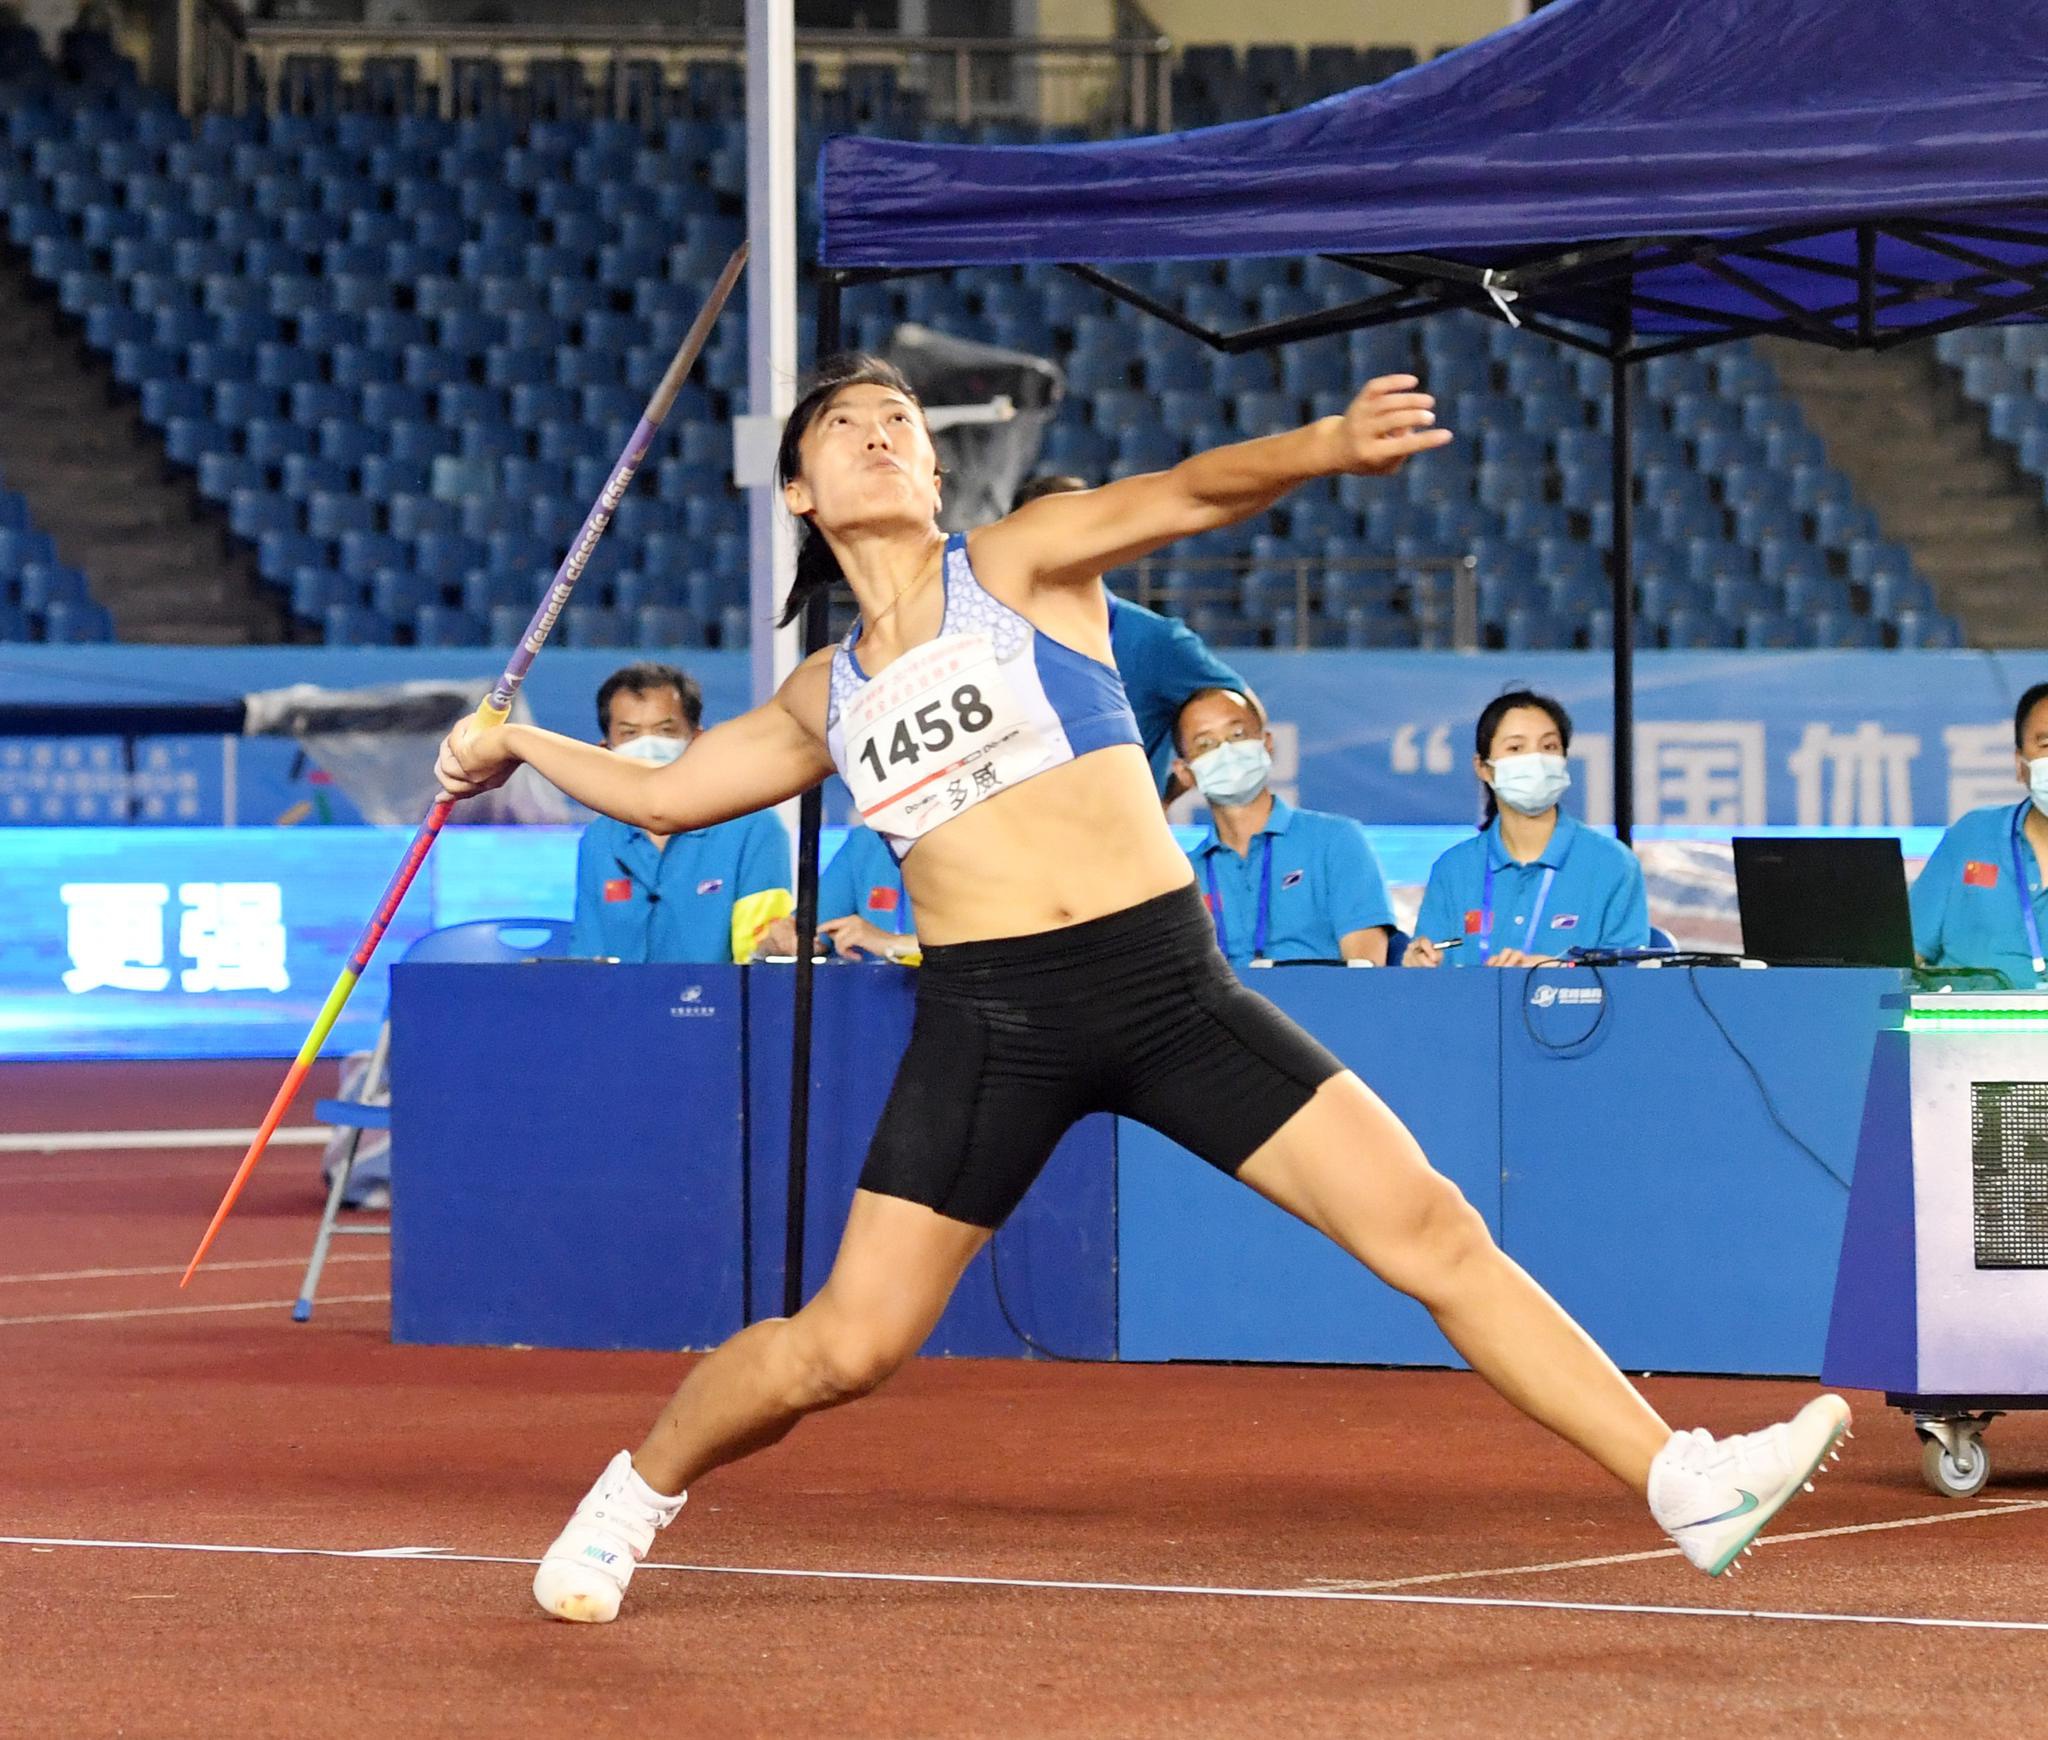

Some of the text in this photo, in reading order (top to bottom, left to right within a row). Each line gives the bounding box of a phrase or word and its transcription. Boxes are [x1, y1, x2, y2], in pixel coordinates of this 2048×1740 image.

[567, 513, 610, 581] classic
[860, 684, 993, 783] 1458
[946, 761, 1003, 811] 多威
[61, 882, 290, 993] 更强
[584, 1545, 618, 1565] NIKE
